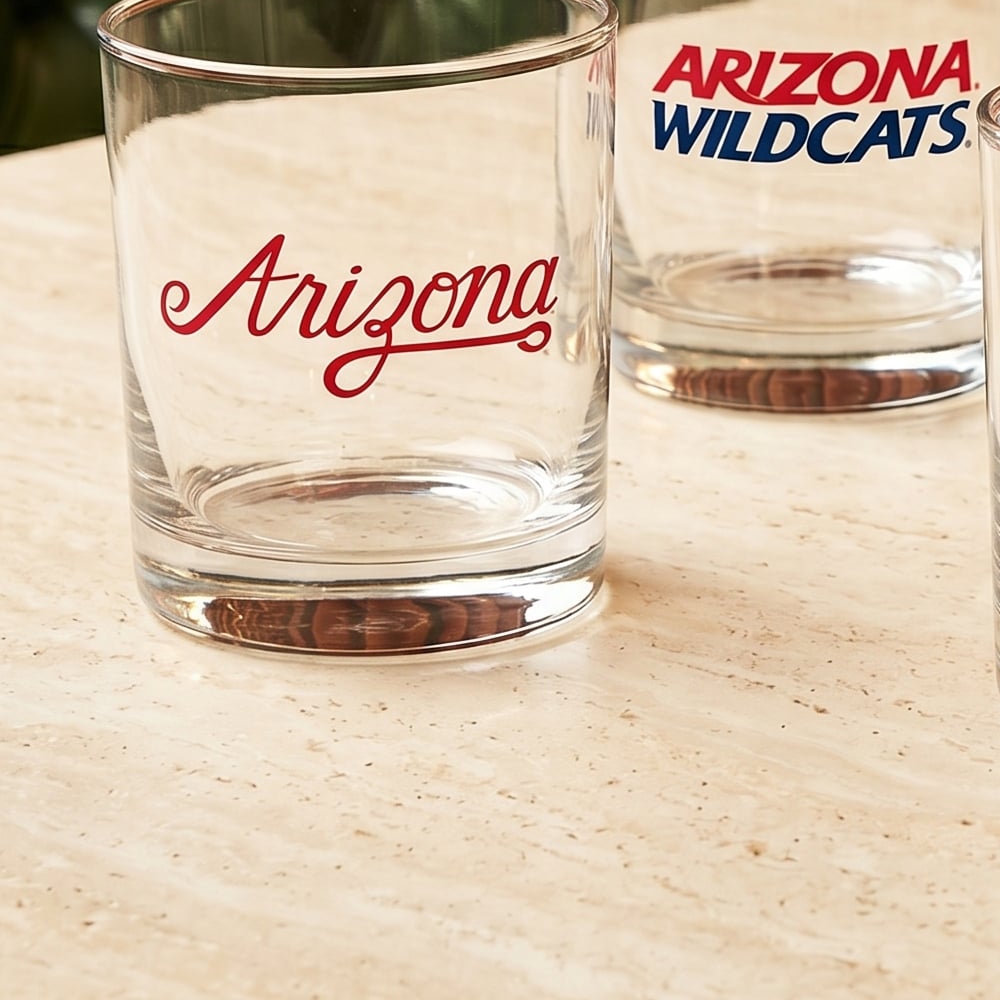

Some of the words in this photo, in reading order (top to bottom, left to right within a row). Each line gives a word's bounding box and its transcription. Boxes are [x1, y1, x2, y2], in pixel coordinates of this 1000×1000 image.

[652, 39, 972, 106] ARIZONA
[652, 99, 971, 165] WILDCATS
[160, 233, 560, 398] Arizona
